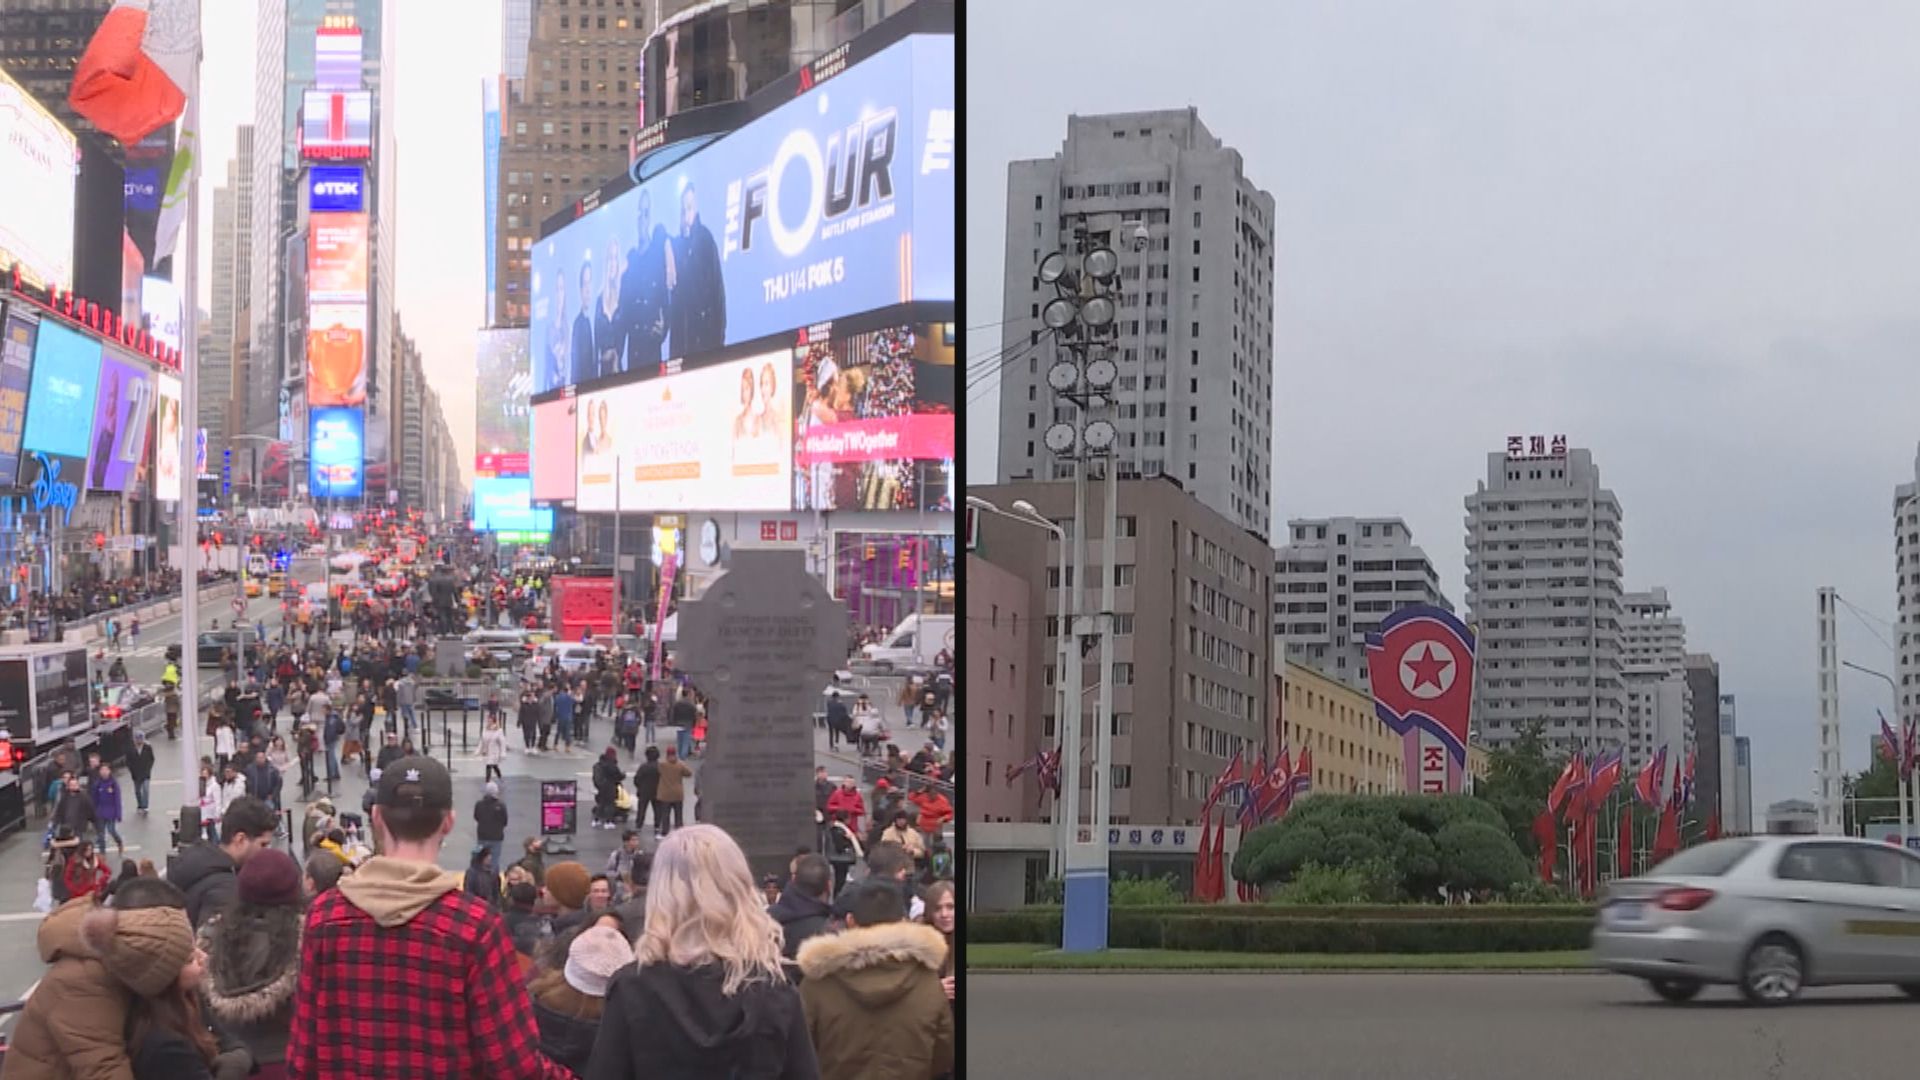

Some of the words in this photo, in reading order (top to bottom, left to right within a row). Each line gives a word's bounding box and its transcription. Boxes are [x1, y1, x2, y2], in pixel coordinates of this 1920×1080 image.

[814, 41, 850, 71] MARRIOTT
[814, 57, 846, 83] MARQUIS
[636, 119, 669, 142] MARRIOTT
[302, 145, 371, 159] TOSHIBA
[324, 181, 359, 196] TDK
[763, 270, 789, 303] THU
[807, 260, 833, 290] FOX
[833, 255, 844, 284] 5
[806, 428, 899, 454] #HolidayTWOgether
